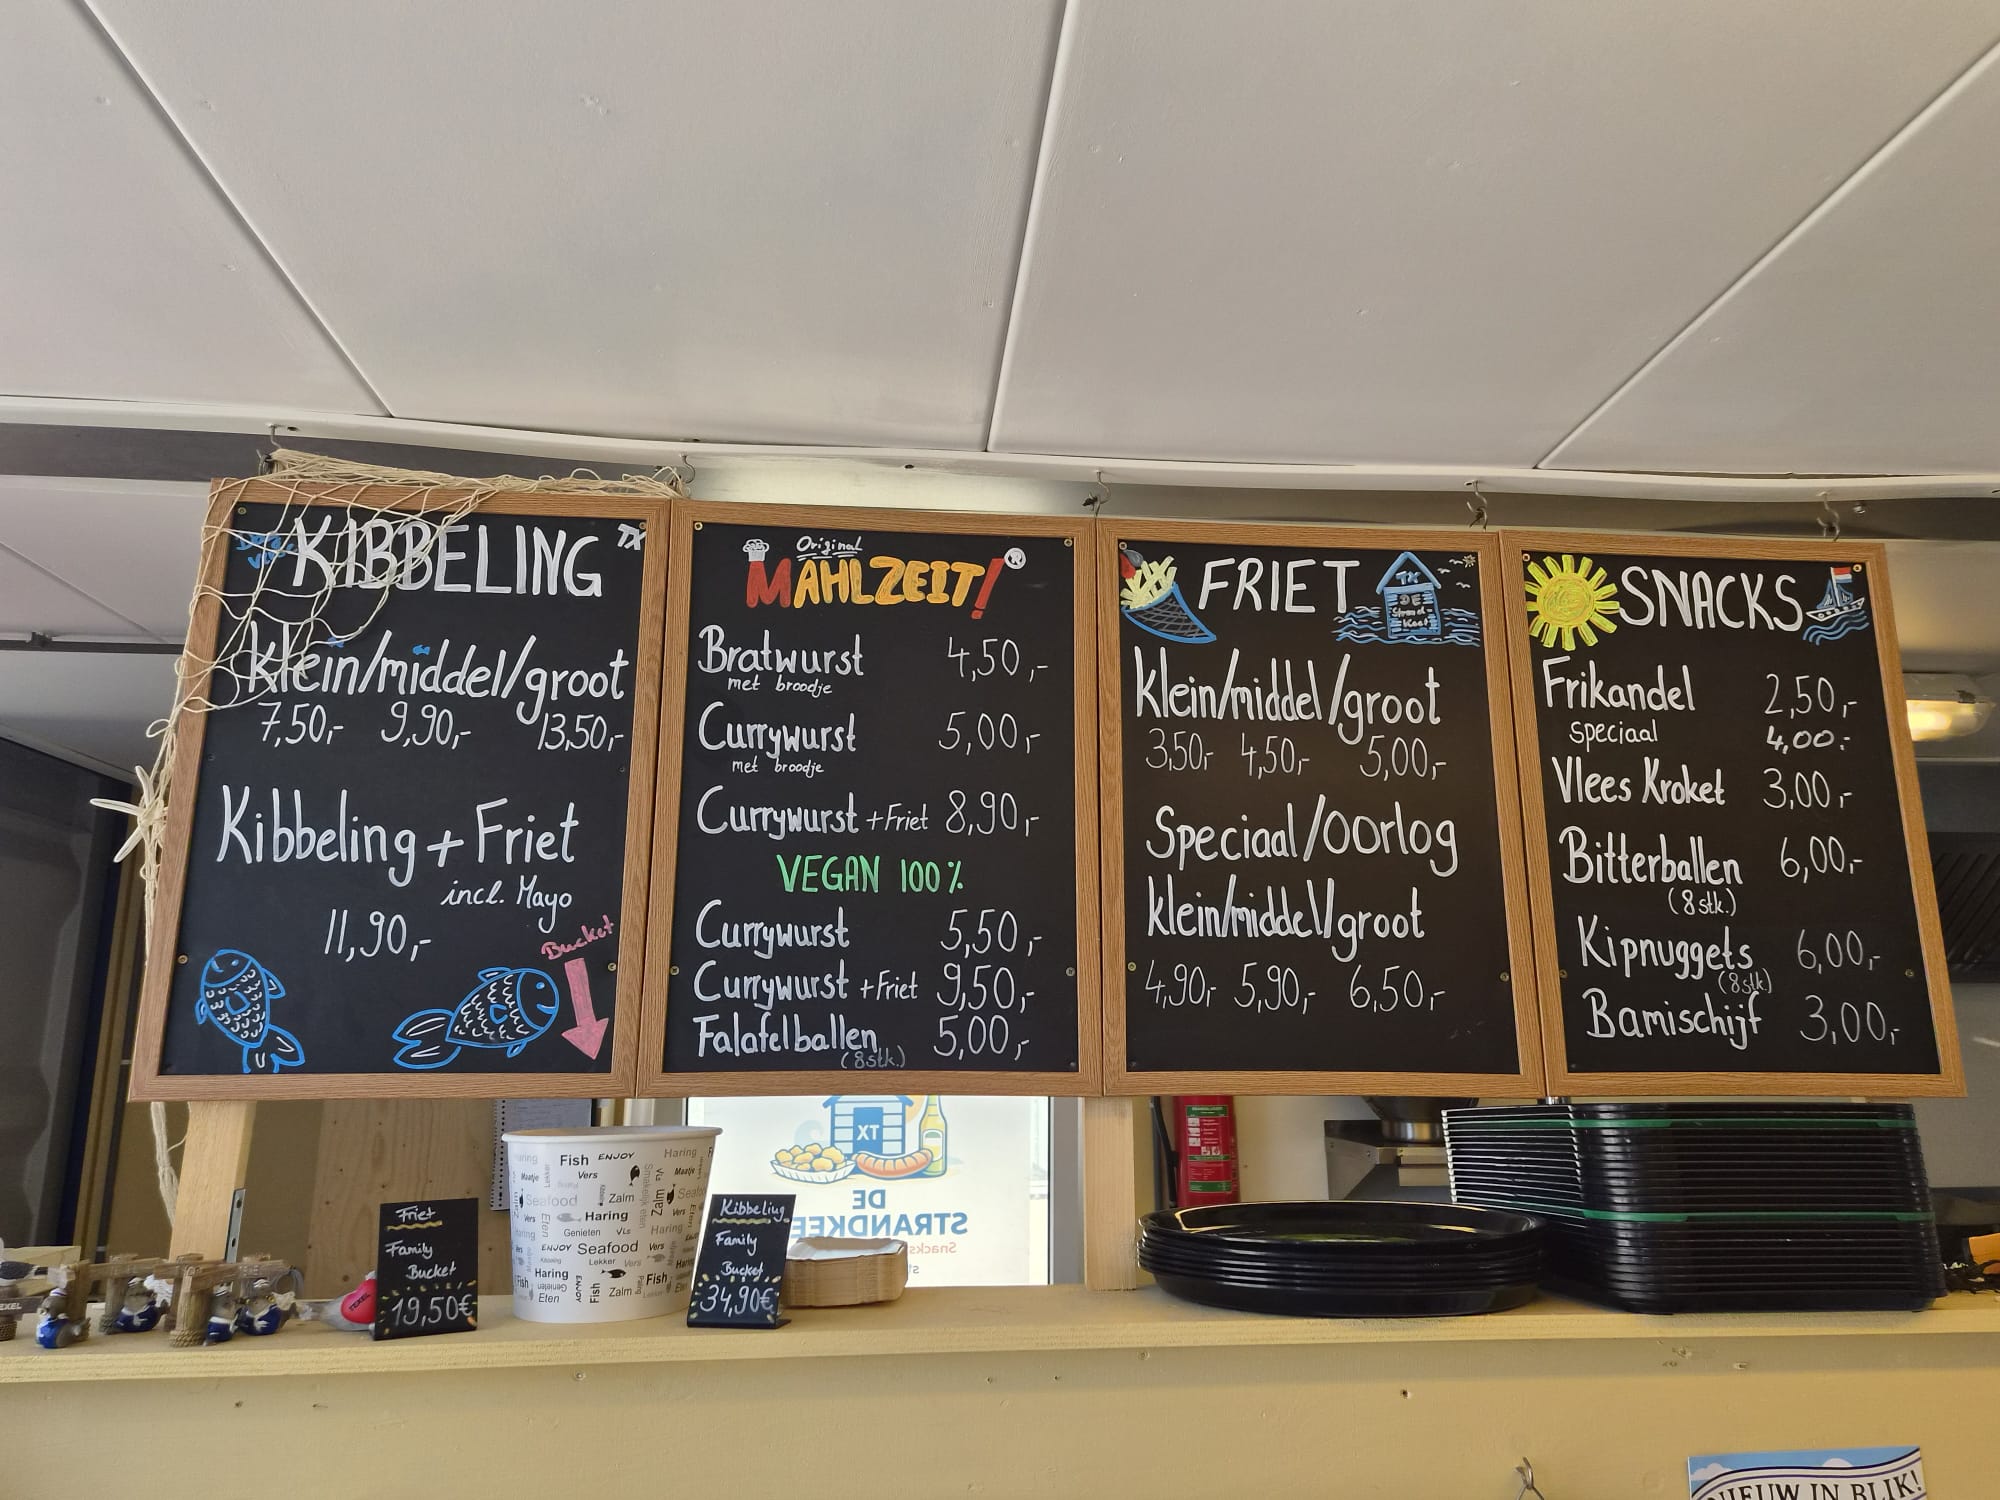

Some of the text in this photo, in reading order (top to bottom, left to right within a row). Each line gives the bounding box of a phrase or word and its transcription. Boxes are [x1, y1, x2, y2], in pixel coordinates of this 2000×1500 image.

[617, 523, 646, 551] TX
[796, 535, 864, 556] Original
[292, 514, 602, 597] KIBBELING
[746, 556, 1005, 620] MAHLZEIT!
[1198, 557, 1361, 614] FRIET
[1395, 570, 1421, 585] TX
[1617, 565, 1803, 633] SNACKS
[698, 624, 864, 677] Bratwurst
[727, 674, 832, 698] met broodje
[1542, 655, 1696, 711] Frikandel
[698, 701, 857, 759] Currywurst
[1569, 719, 1658, 753] speciaal
[732, 757, 825, 779] met broodje
[1551, 756, 1632, 804] Vlees
[1641, 756, 1726, 806] Kroket
[697, 785, 859, 841] Currywurst
[216, 784, 579, 887] Kibbeling + Friet
[1558, 825, 1743, 885] Bitterballen
[776, 854, 880, 893] VEGAN
[440, 874, 573, 933] incl. Mayo
[540, 915, 615, 960] Bucket
[695, 899, 850, 960] Currywurst
[1577, 914, 1754, 980] Kipnuggets
[693, 959, 849, 1011] Currywurst
[1582, 987, 1764, 1050] Bamischijf
[692, 1011, 879, 1058] Falafelballen
[560, 1154, 589, 1167] Fish
[598, 1152, 635, 1162] ENJOY
[664, 1147, 697, 1159] Haring
[578, 1170, 598, 1180] Vers
[608, 1192, 635, 1204] Zalm
[650, 1188, 666, 1216] Zalm
[720, 1198, 785, 1222] Kibbeling
[395, 1205, 437, 1223] Friet
[585, 1211, 629, 1223] Haring
[563, 1228, 601, 1238] Genieten
[651, 1223, 684, 1236] Haring
[384, 1240, 433, 1259] Family
[541, 1243, 572, 1252] ENJOY
[577, 1240, 639, 1256] Seafood
[649, 1242, 665, 1252] Vers
[715, 1230, 757, 1257] Family
[405, 1260, 457, 1280] Bucket
[589, 1257, 616, 1266] Lekker
[720, 1260, 764, 1279] Bucket
[535, 1267, 569, 1281] Haring
[646, 1271, 668, 1286] Fish
[538, 1292, 560, 1303] Eten
[589, 1282, 601, 1304] Fish
[608, 1287, 633, 1298] Zalm
[699, 1284, 775, 1318] 34,90€
[391, 1294, 474, 1327] 19,50€
